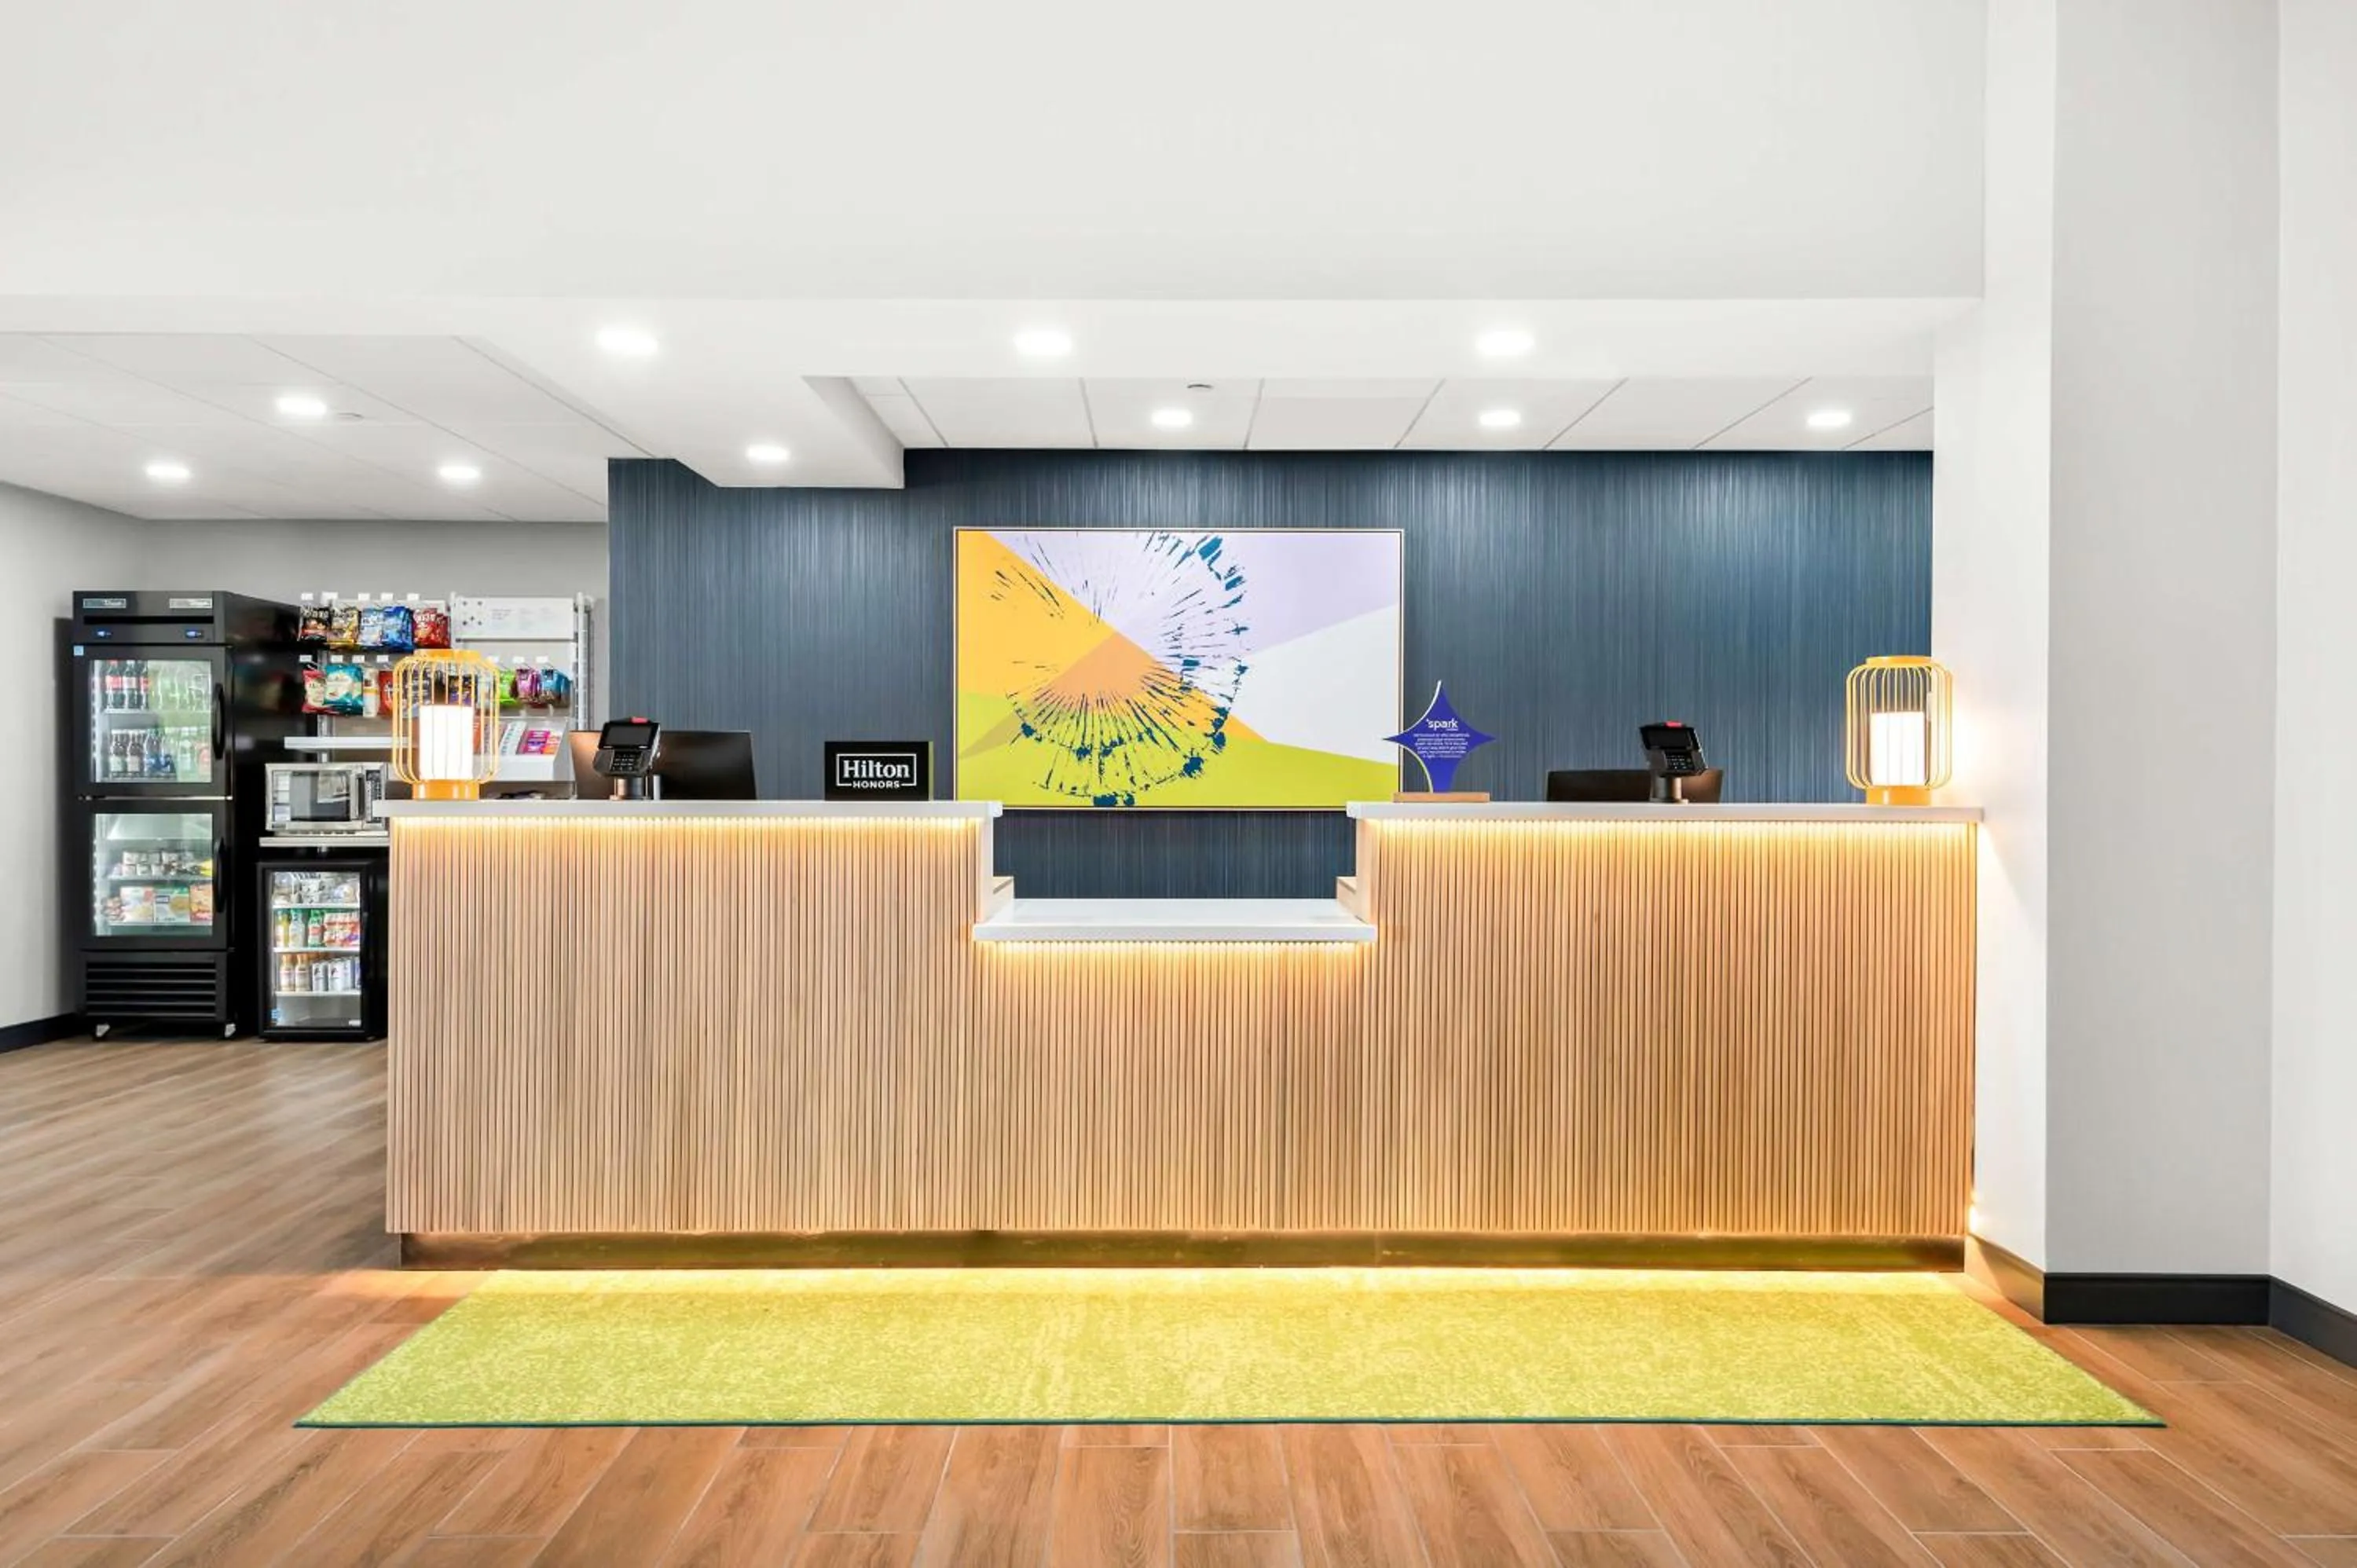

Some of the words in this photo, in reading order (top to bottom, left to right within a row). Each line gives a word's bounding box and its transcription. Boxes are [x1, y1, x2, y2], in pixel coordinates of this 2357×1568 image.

[1428, 718, 1459, 731] spark
[843, 760, 911, 779] Hilton
[852, 780, 900, 789] HONORS
